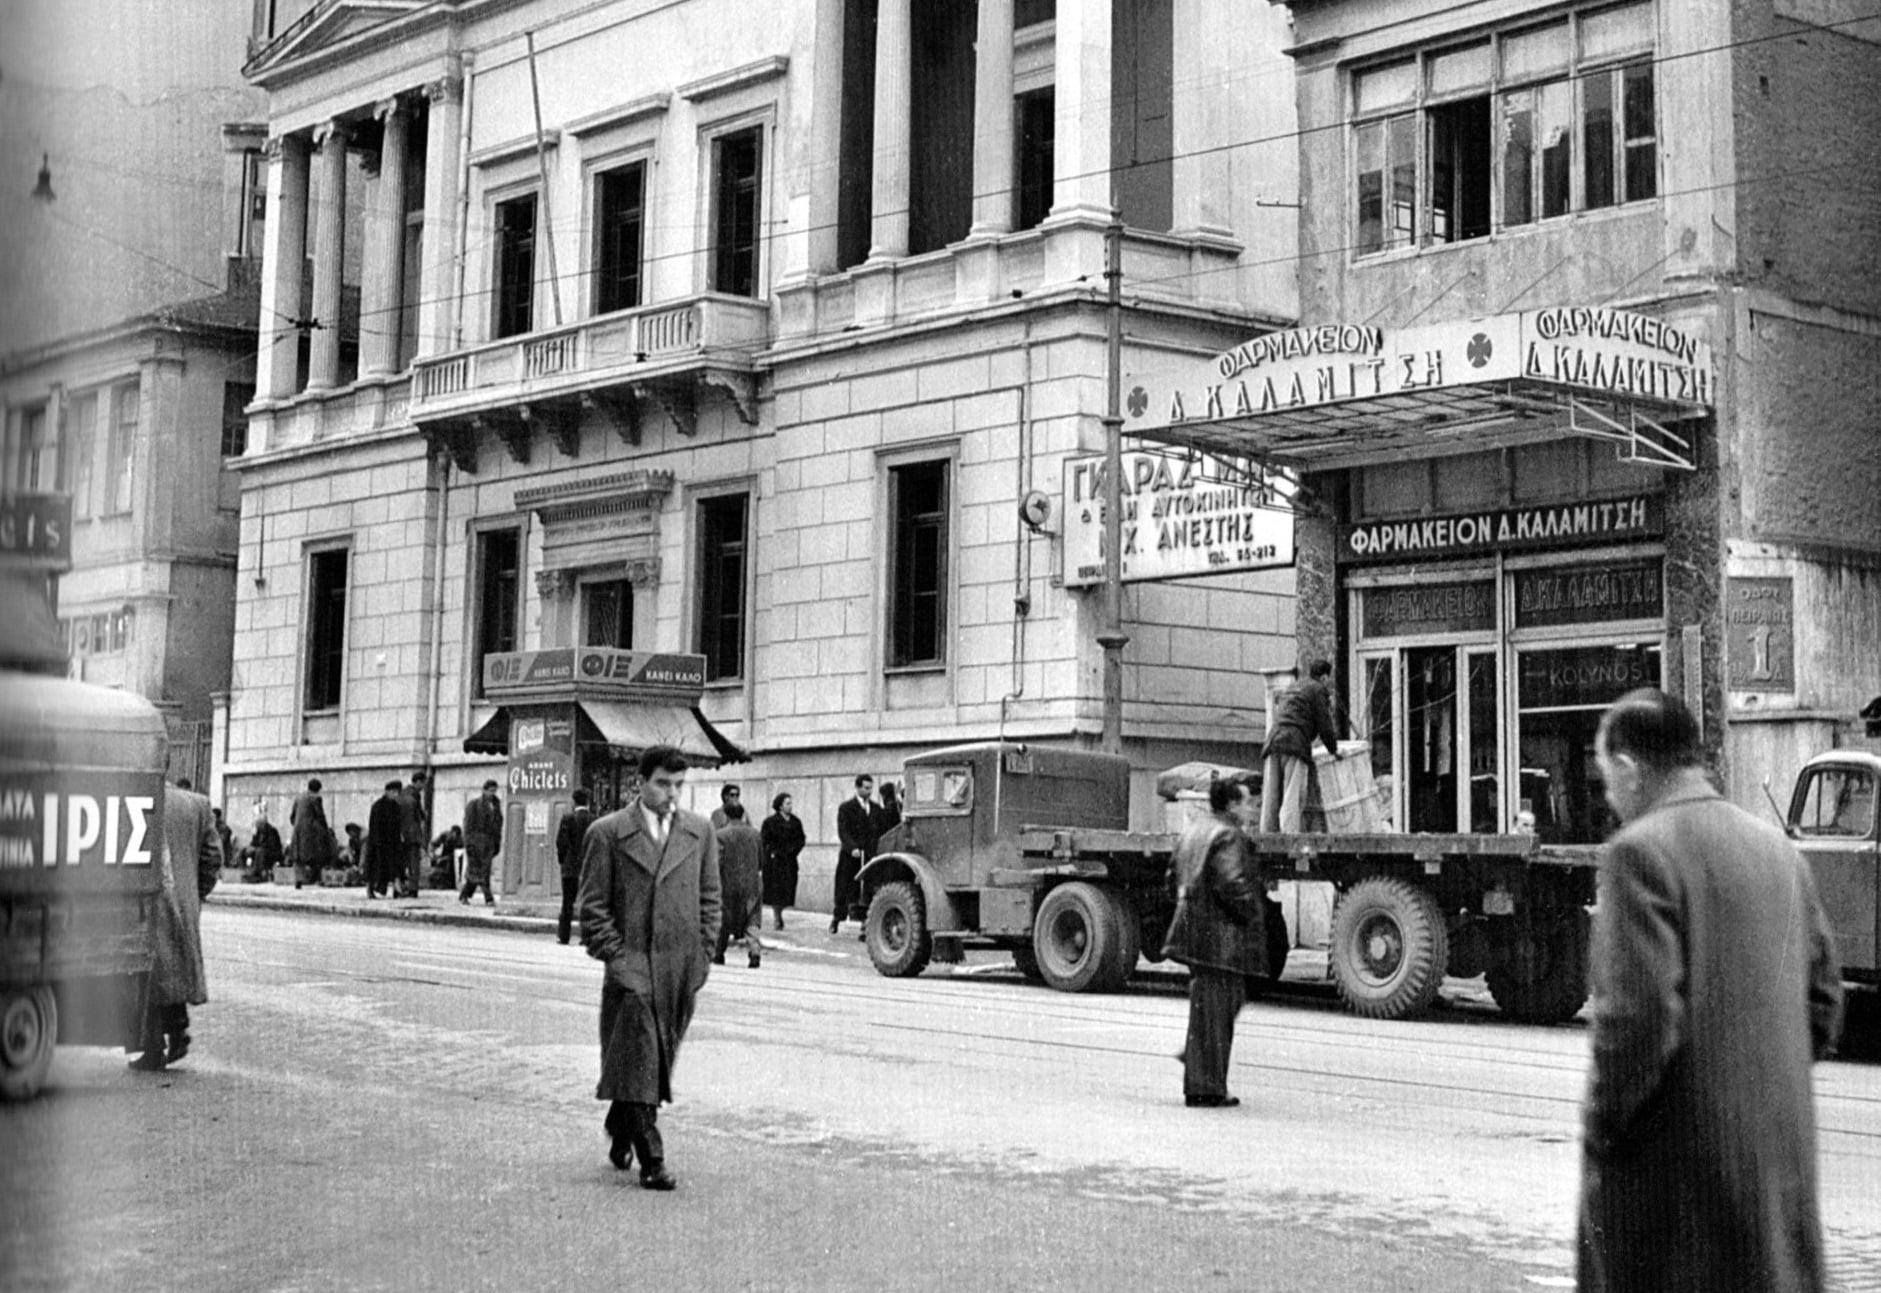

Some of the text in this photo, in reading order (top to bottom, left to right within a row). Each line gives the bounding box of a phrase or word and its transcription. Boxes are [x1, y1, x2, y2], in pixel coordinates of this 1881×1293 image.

[1219, 325, 1383, 379] ΦΑΡΜΑΚΕΙΟΝ
[1537, 308, 1698, 366] ΦΑΡΜΑΚΕΙΟΝ
[1157, 512, 1254, 551] ΑΝΕΣΤΗΣ
[1351, 515, 1492, 554] ΦΑΡΜΑΚΕΙΟΝ
[1549, 665, 1643, 686] KOLYNOS
[509, 766, 568, 794] Chiclets
[42, 791, 155, 867] ΙΡΙΣ
